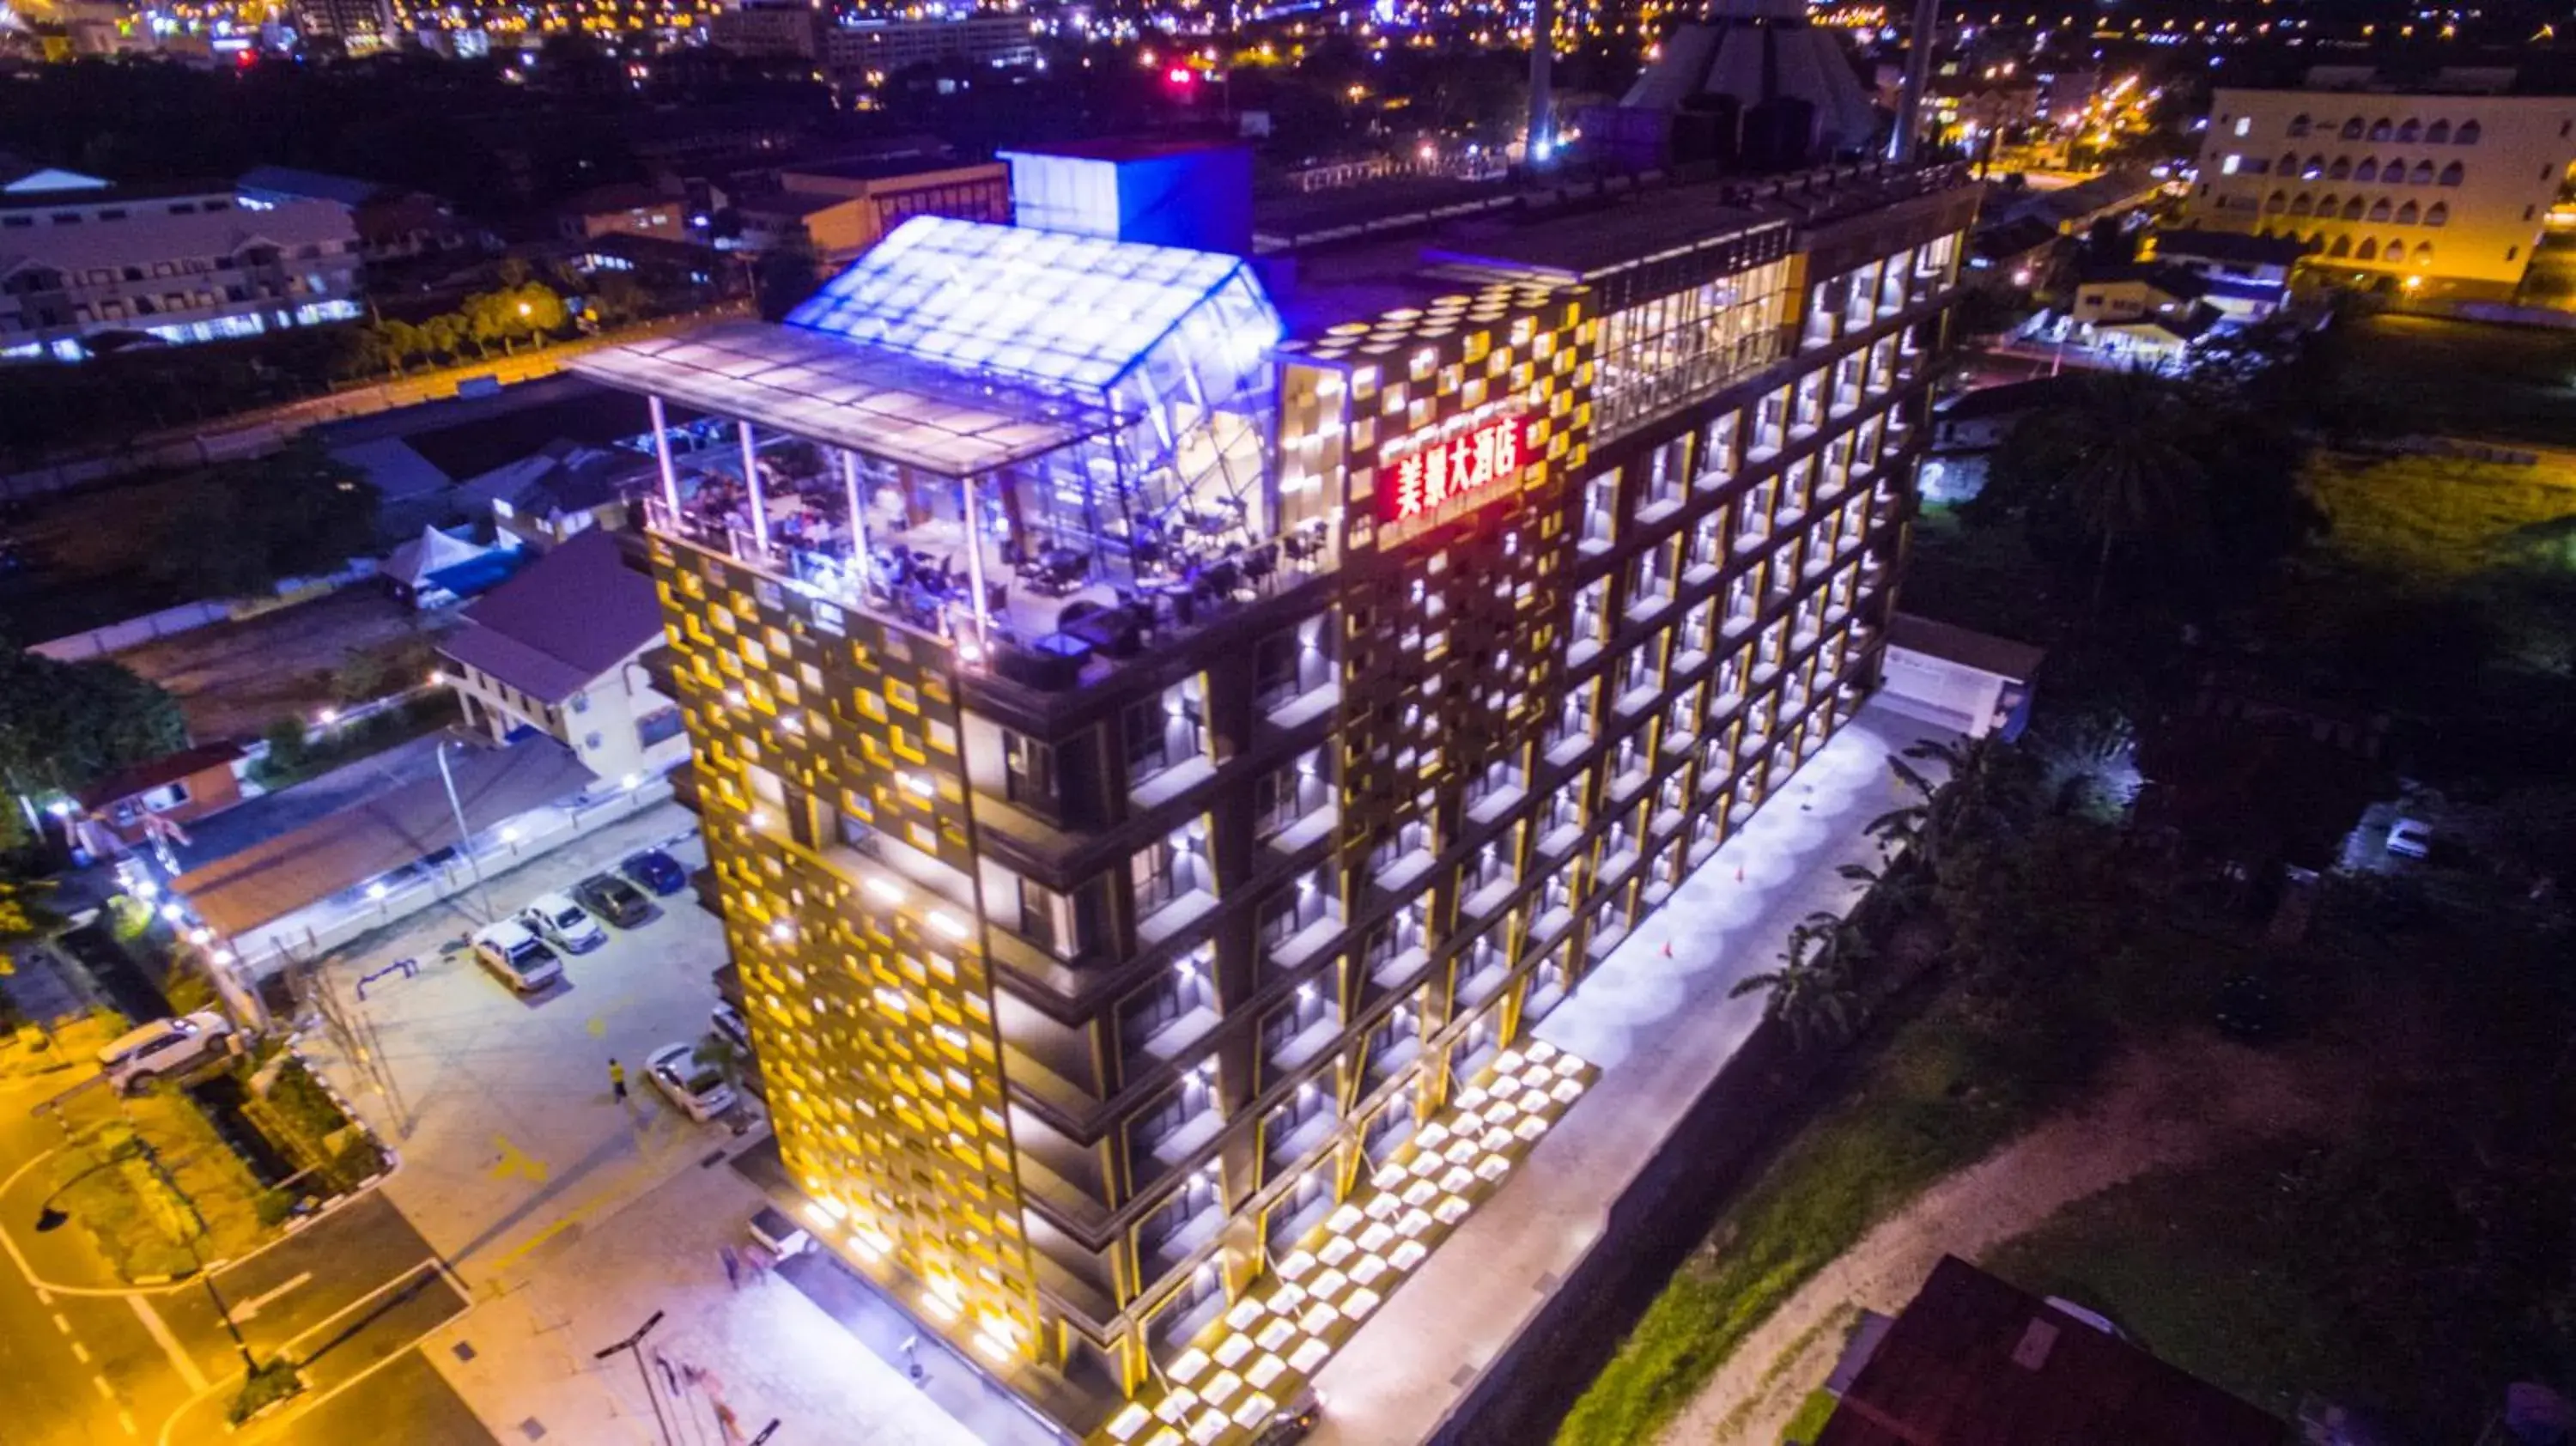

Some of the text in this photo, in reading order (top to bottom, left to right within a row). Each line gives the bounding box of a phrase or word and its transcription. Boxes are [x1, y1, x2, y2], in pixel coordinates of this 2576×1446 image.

[1397, 417, 1518, 519] 美景大酒店
